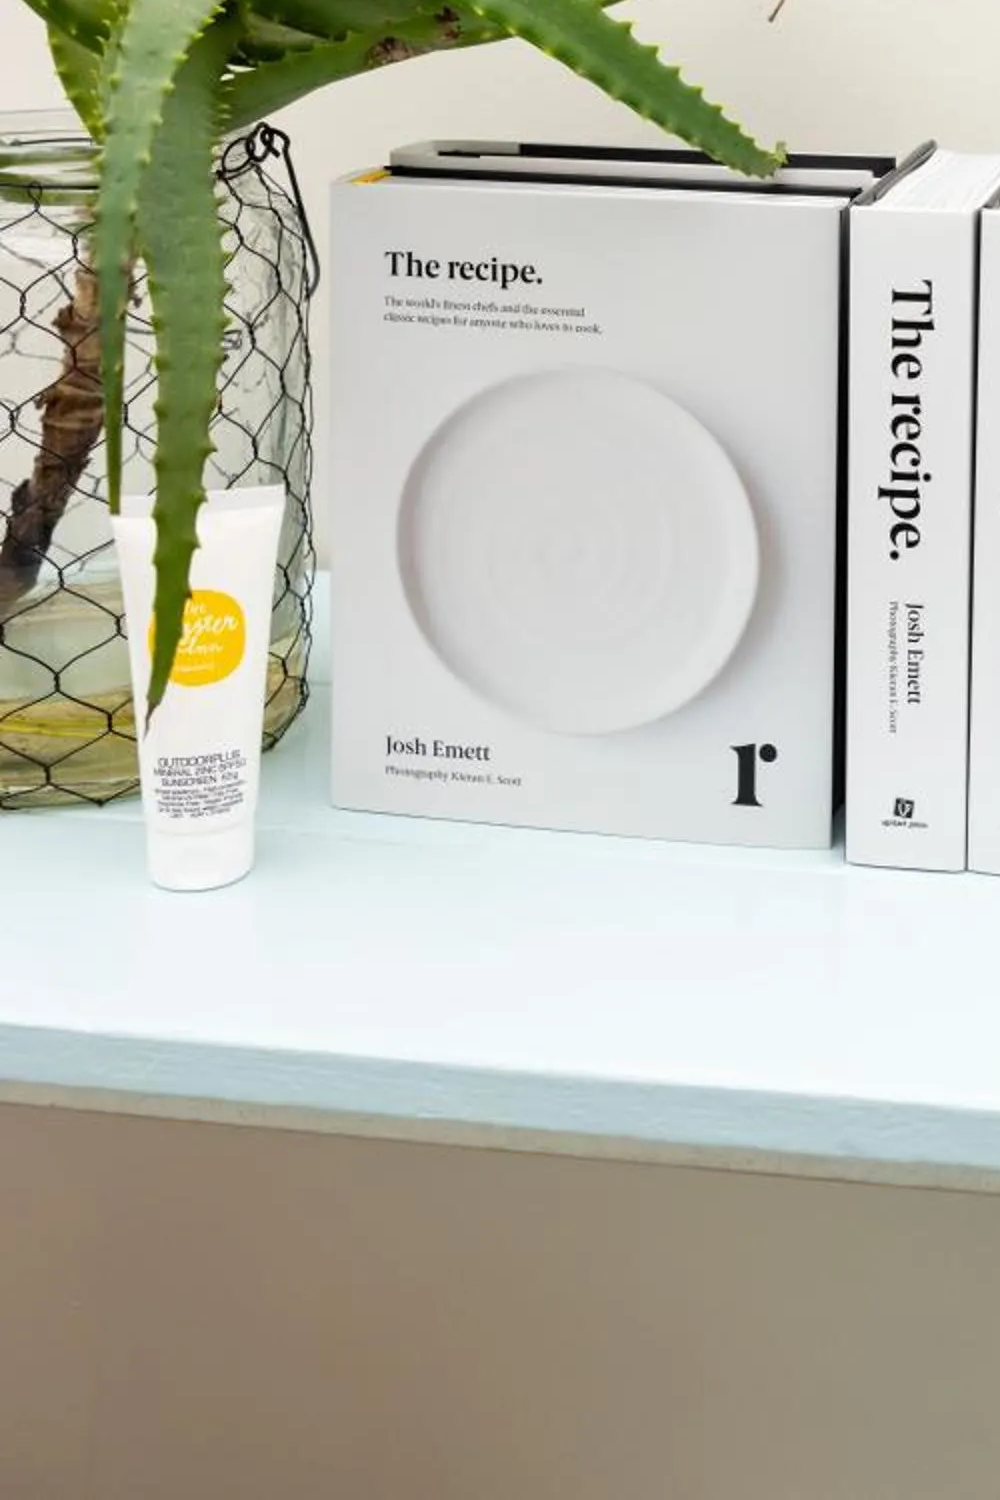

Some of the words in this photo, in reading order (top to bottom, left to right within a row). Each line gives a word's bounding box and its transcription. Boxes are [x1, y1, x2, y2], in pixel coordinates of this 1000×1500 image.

[384, 250, 440, 278] The
[448, 257, 543, 289] recipe.
[384, 296, 401, 307] The
[472, 301, 499, 313] chefs
[500, 303, 521, 314] and
[522, 304, 540, 315] the
[453, 315, 467, 326] for
[510, 319, 533, 330] who
[563, 323, 573, 333] to
[891, 279, 935, 380] The
[878, 393, 932, 560] recipe.
[888, 601, 899, 663] Photography
[905, 603, 925, 643] Josh
[907, 649, 925, 705] Emett
[386, 735, 427, 756] Josh
[433, 740, 491, 761] Emett
[385, 765, 448, 782] Photography
[497, 775, 521, 786] Scott
[729, 743, 778, 807] r
